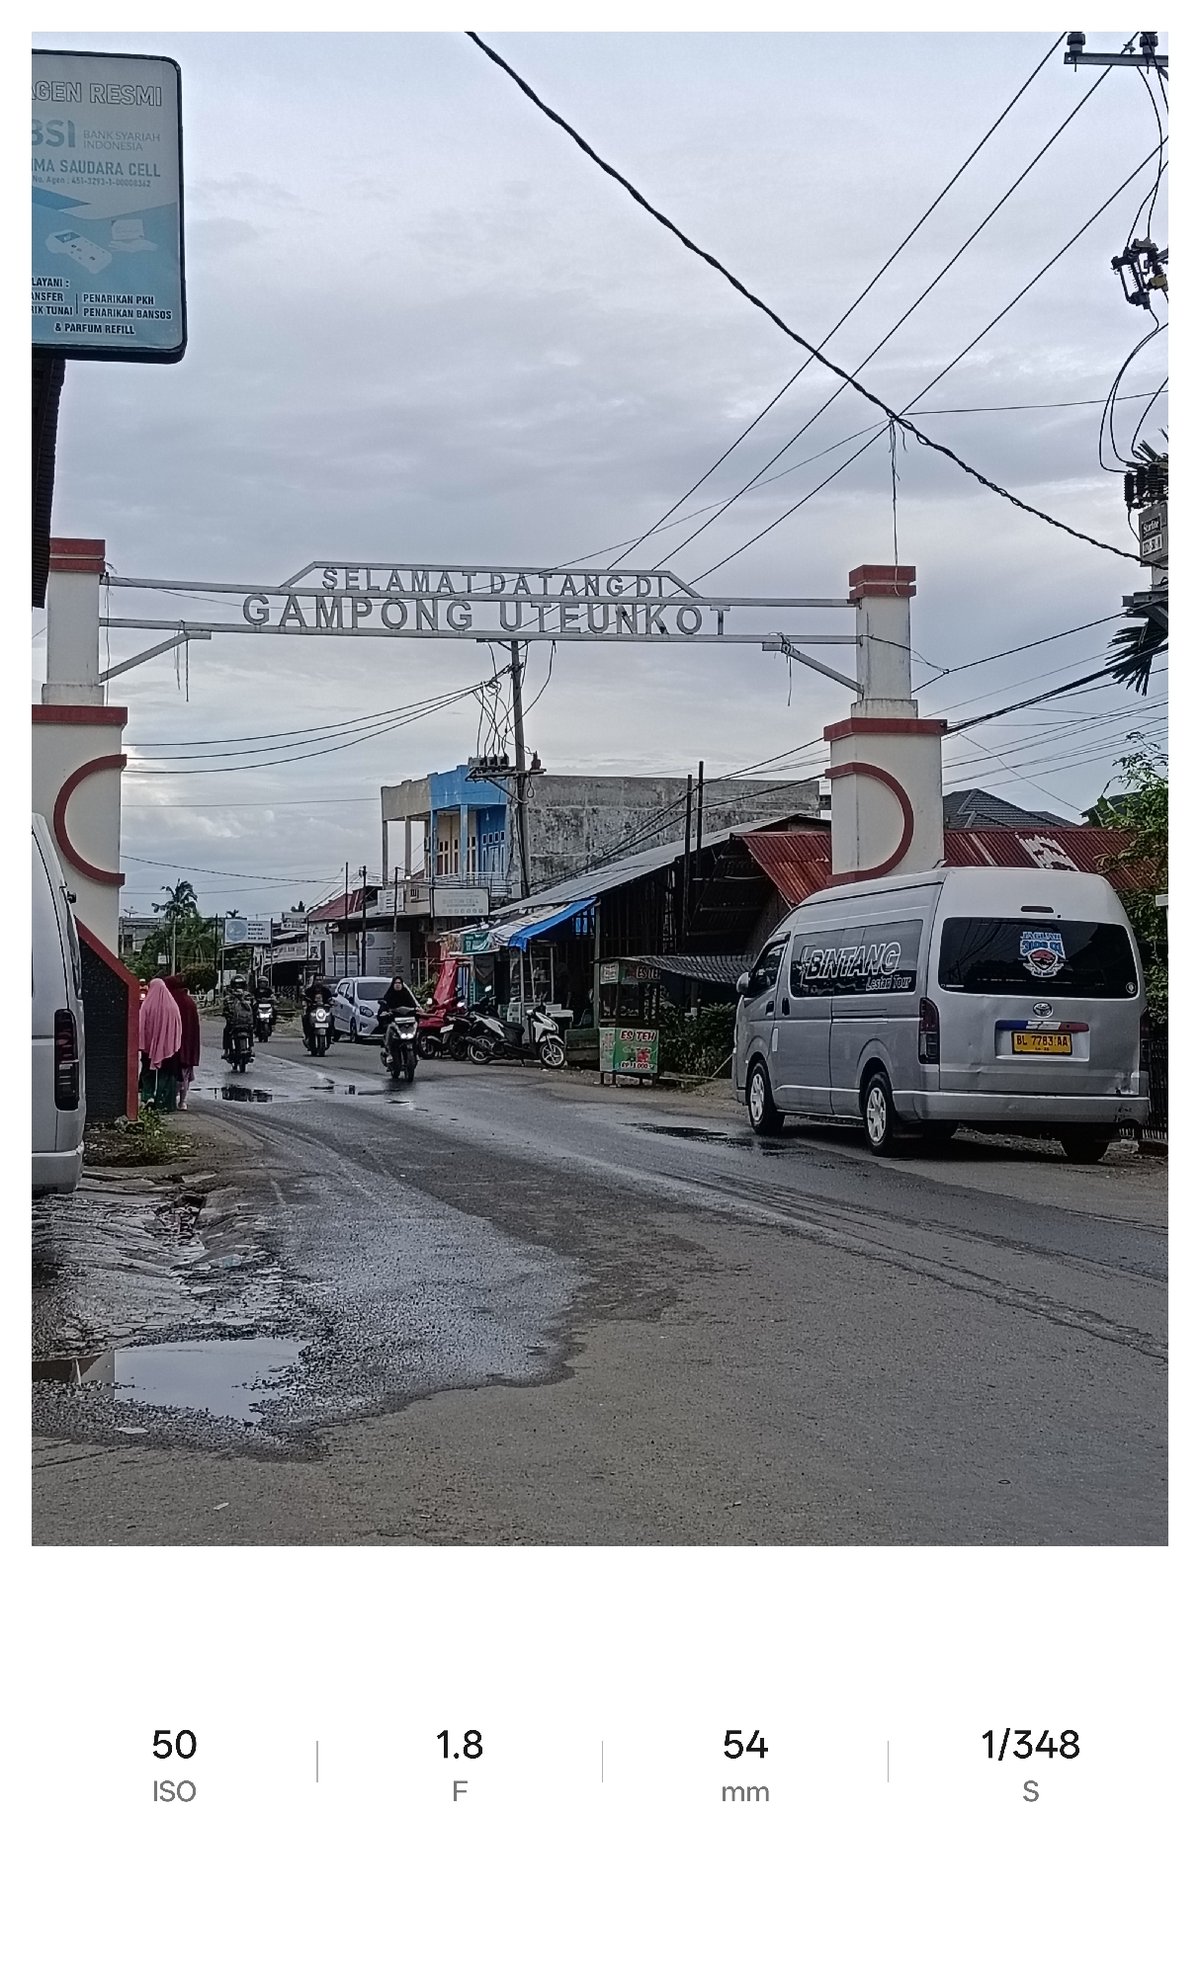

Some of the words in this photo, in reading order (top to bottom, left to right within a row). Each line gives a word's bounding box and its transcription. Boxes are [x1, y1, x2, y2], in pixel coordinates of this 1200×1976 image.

[32, 80, 82, 103] GEN
[89, 83, 162, 107] RESMI
[83, 129, 113, 141] BANK
[114, 131, 161, 143] SYARIAH
[83, 140, 144, 152] INDONESIA
[60, 159, 124, 177] SAUDARA
[128, 162, 161, 178] CELL
[83, 293, 134, 305] PENARIKAN
[136, 295, 155, 306] PKH
[46, 306, 73, 316] TUNAI
[83, 307, 134, 319] PENARIKAN
[136, 309, 172, 320] BANSOS
[55, 322, 62, 333] &
[64, 323, 103, 334] PARFUM
[105, 324, 135, 335] REFILL
[322, 567, 477, 594] SELAMAT
[490, 572, 624, 598] DATANG
[635, 574, 663, 598] DI
[242, 593, 474, 632] GAMPONG
[499, 601, 731, 636] UTEUNKOT
[804, 941, 902, 980] BINTANG
[893, 975, 912, 990] Tour
[620, 1029, 635, 1041] ES
[635, 1030, 657, 1042] TEH
[1016, 1034, 1028, 1046] BL
[1031, 1035, 1054, 1046] 7783
[1057, 1036, 1068, 1046] AA
